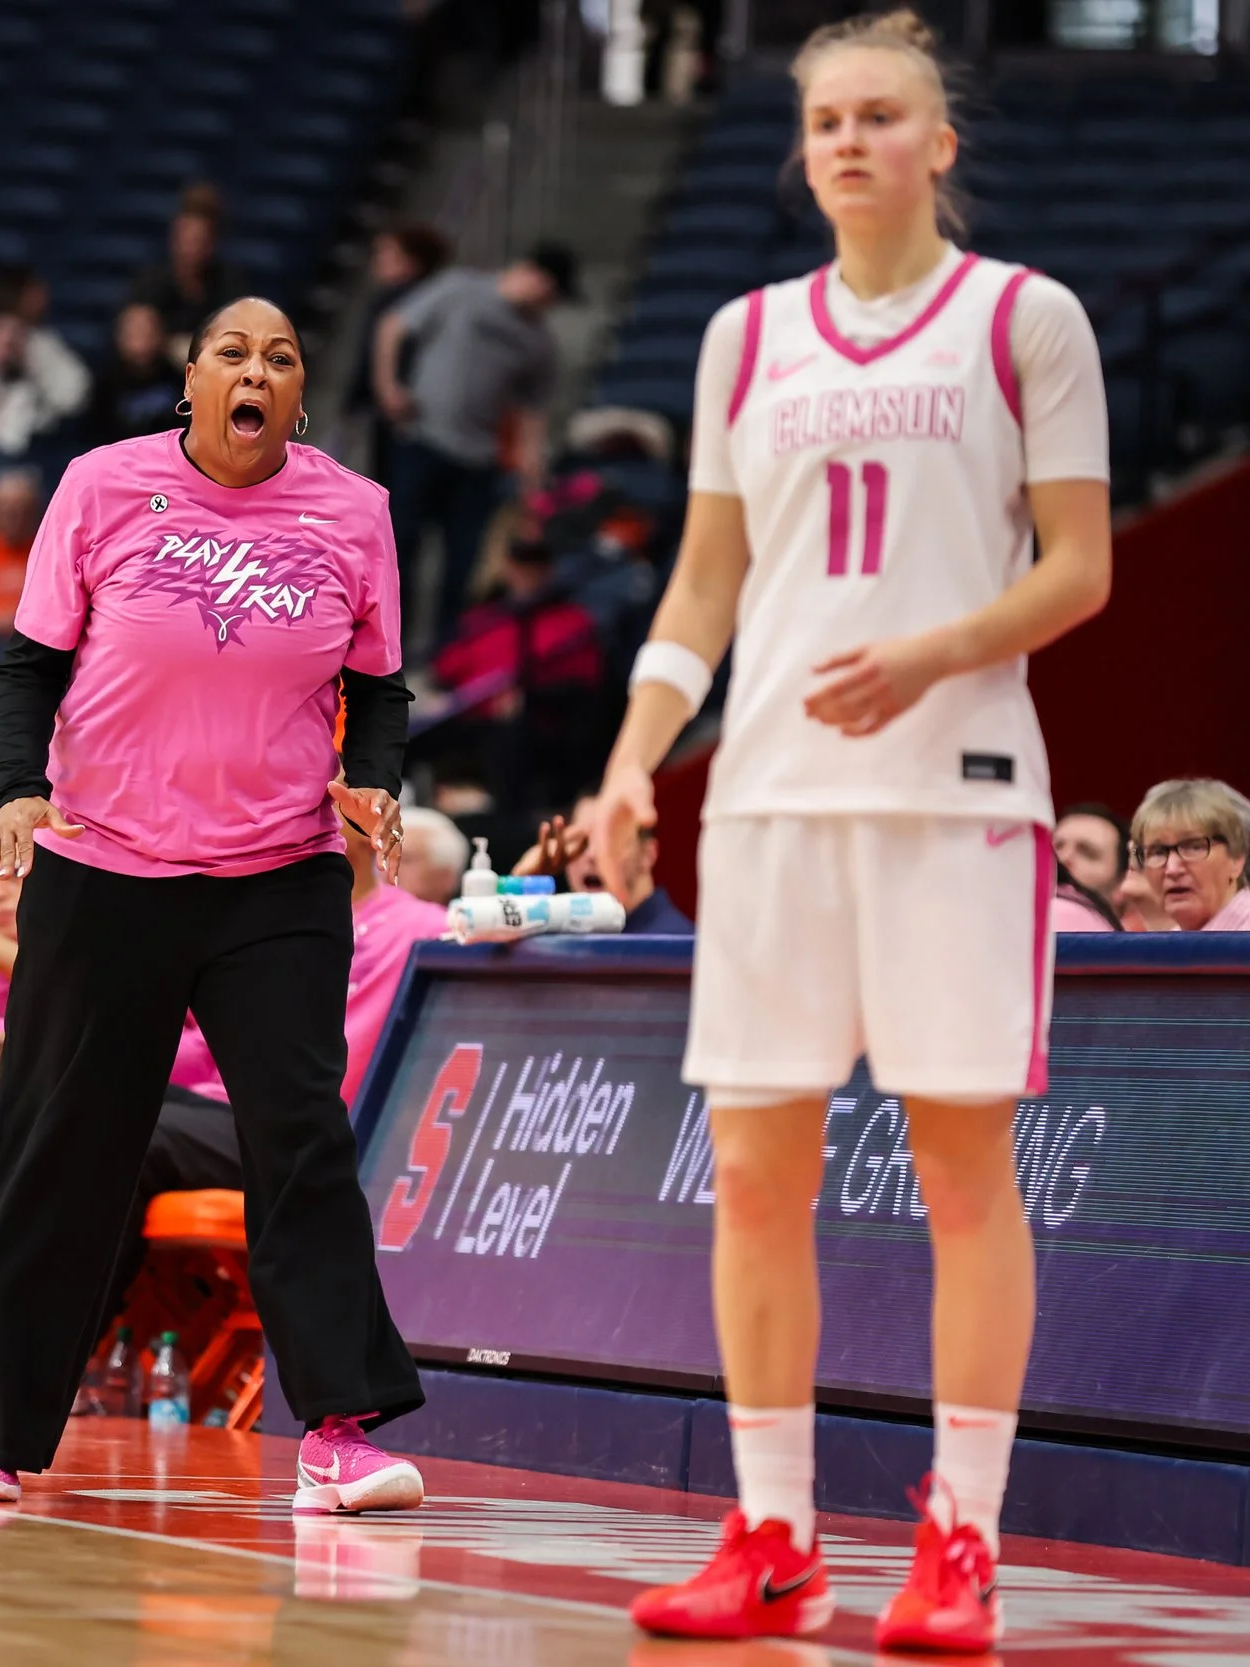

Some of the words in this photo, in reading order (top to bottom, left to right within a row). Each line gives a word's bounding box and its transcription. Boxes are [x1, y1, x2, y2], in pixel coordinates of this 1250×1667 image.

[773, 385, 966, 455] CLEMSON
[825, 459, 888, 577] 11
[152, 535, 233, 570] PLAY
[210, 542, 269, 605] 4
[240, 582, 316, 619] KAY
[492, 1049, 636, 1155] Hidden
[454, 1157, 573, 1260] Level
[466, 1347, 512, 1366] DAKTRONICS
